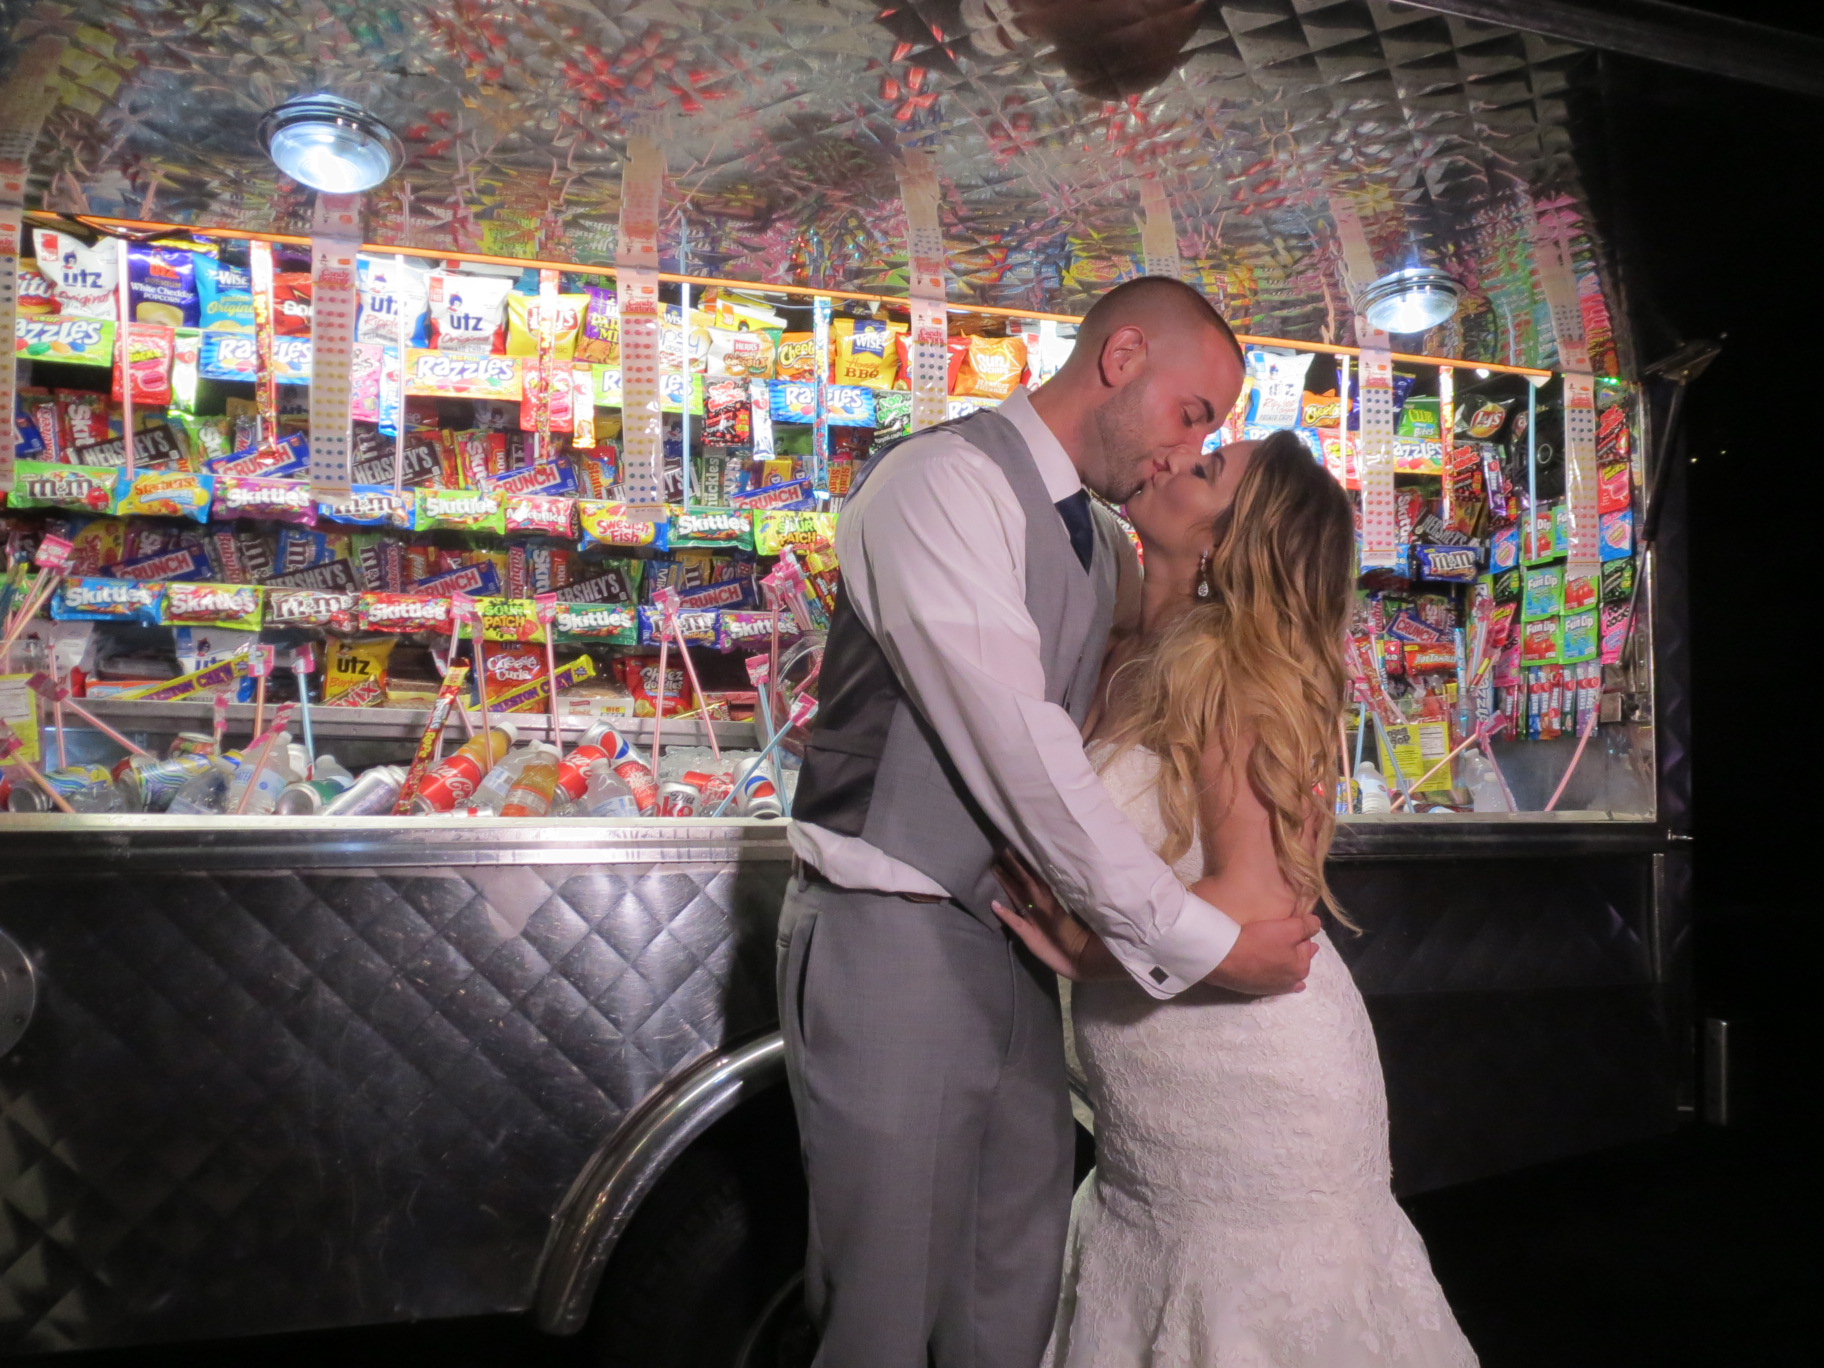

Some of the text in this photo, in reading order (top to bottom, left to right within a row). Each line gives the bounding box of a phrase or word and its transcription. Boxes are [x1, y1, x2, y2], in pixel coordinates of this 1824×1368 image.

[62, 268, 103, 289] utz
[217, 270, 249, 285] WISE
[130, 281, 156, 293] White
[143, 292, 181, 303] POPCORN
[627, 299, 655, 309] Candy
[206, 301, 255, 316] Origin
[625, 304, 657, 314] Buttons
[450, 313, 484, 332] utz
[441, 332, 491, 345] Original
[918, 327, 943, 338] Candy
[856, 333, 883, 350] WISE
[844, 366, 879, 379] BBQ
[226, 487, 312, 507] Skittles
[739, 486, 801, 509] CRUNCH
[426, 495, 498, 517] Skittles
[596, 519, 651, 539] Swedish
[678, 513, 751, 536] Skittles
[609, 528, 641, 544] Fish
[778, 531, 817, 546] PATCH
[1527, 576, 1543, 591] Fun
[1544, 574, 1558, 587] Dip
[65, 586, 152, 608] Skittles
[170, 591, 257, 615] Skittles
[367, 602, 448, 622] Skittles
[484, 604, 527, 617] SOUR
[484, 615, 526, 629] PATCH
[557, 611, 632, 632] Skittles
[729, 618, 800, 640] Skittes
[1396, 617, 1437, 643] CRUNCH
[1526, 621, 1556, 635] Fun Dip
[1564, 616, 1595, 631] Fun Dip
[337, 659, 370, 676] utz
[486, 653, 537, 672] Cheese
[606, 705, 626, 714] BIG
[418, 731, 436, 759] Rope
[670, 789, 696, 806] Diet
